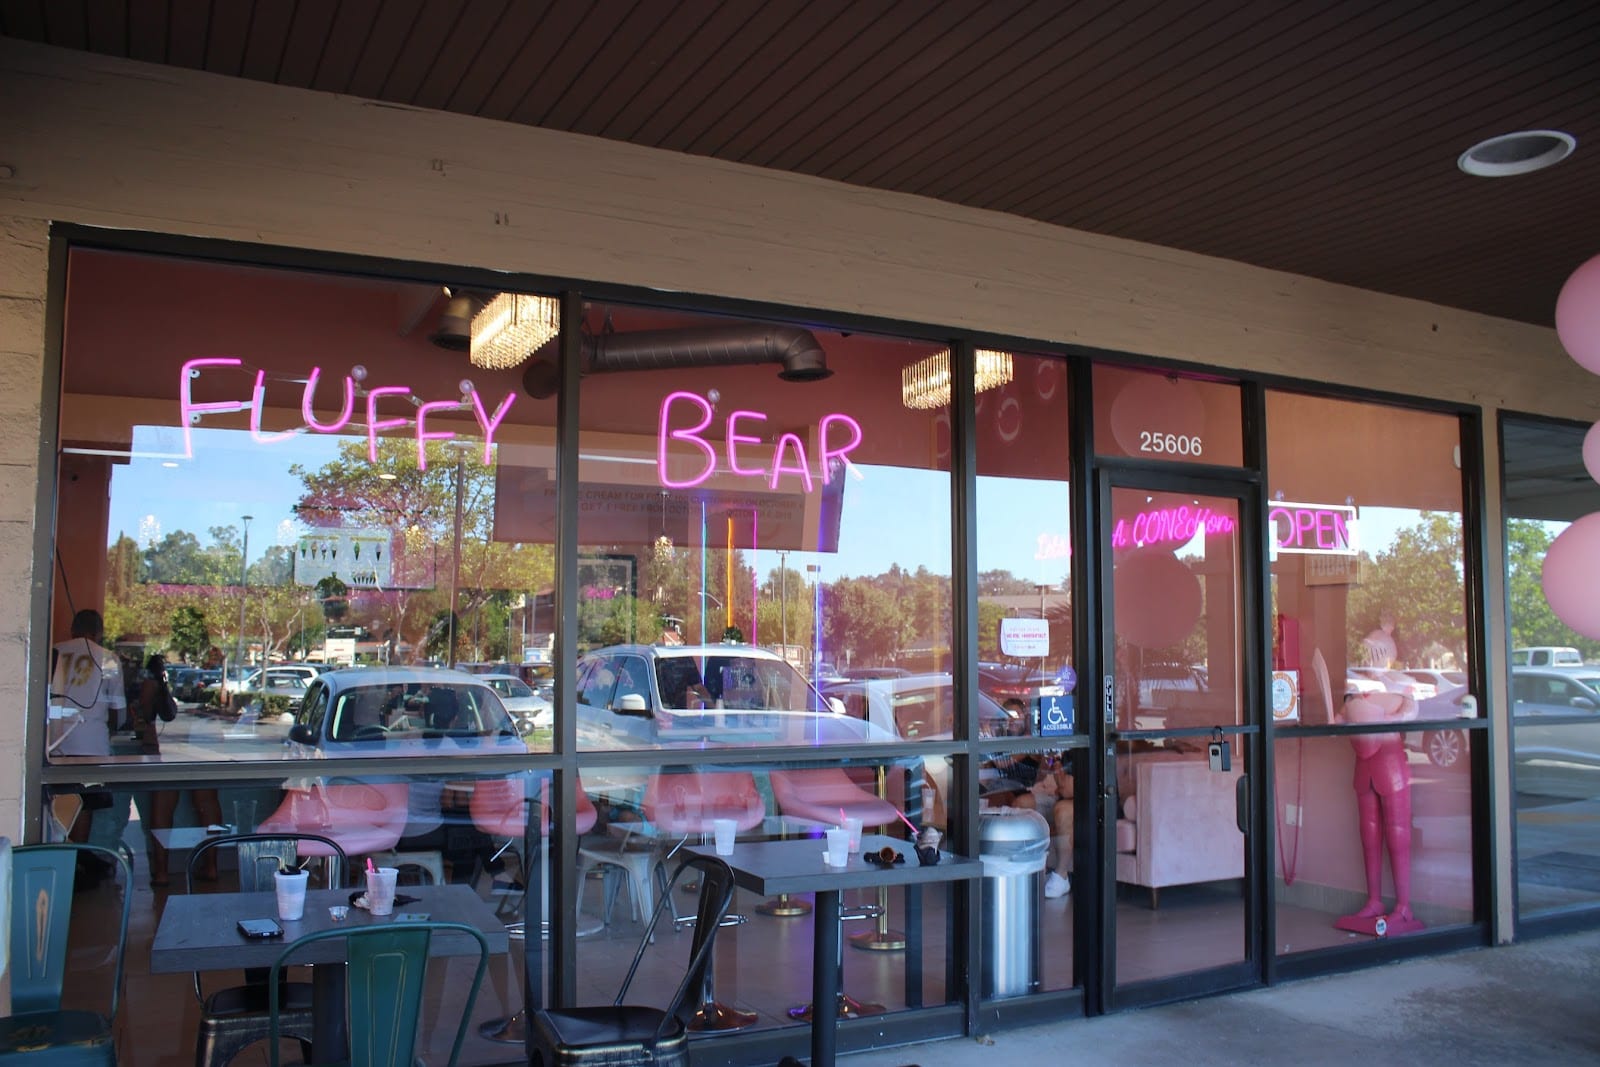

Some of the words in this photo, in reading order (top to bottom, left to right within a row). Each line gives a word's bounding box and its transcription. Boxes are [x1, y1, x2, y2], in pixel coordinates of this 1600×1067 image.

[181, 358, 516, 471] FLUFFY
[658, 391, 864, 492] BEAR
[1140, 431, 1202, 457] 25606
[1269, 507, 1353, 549] OPEN
